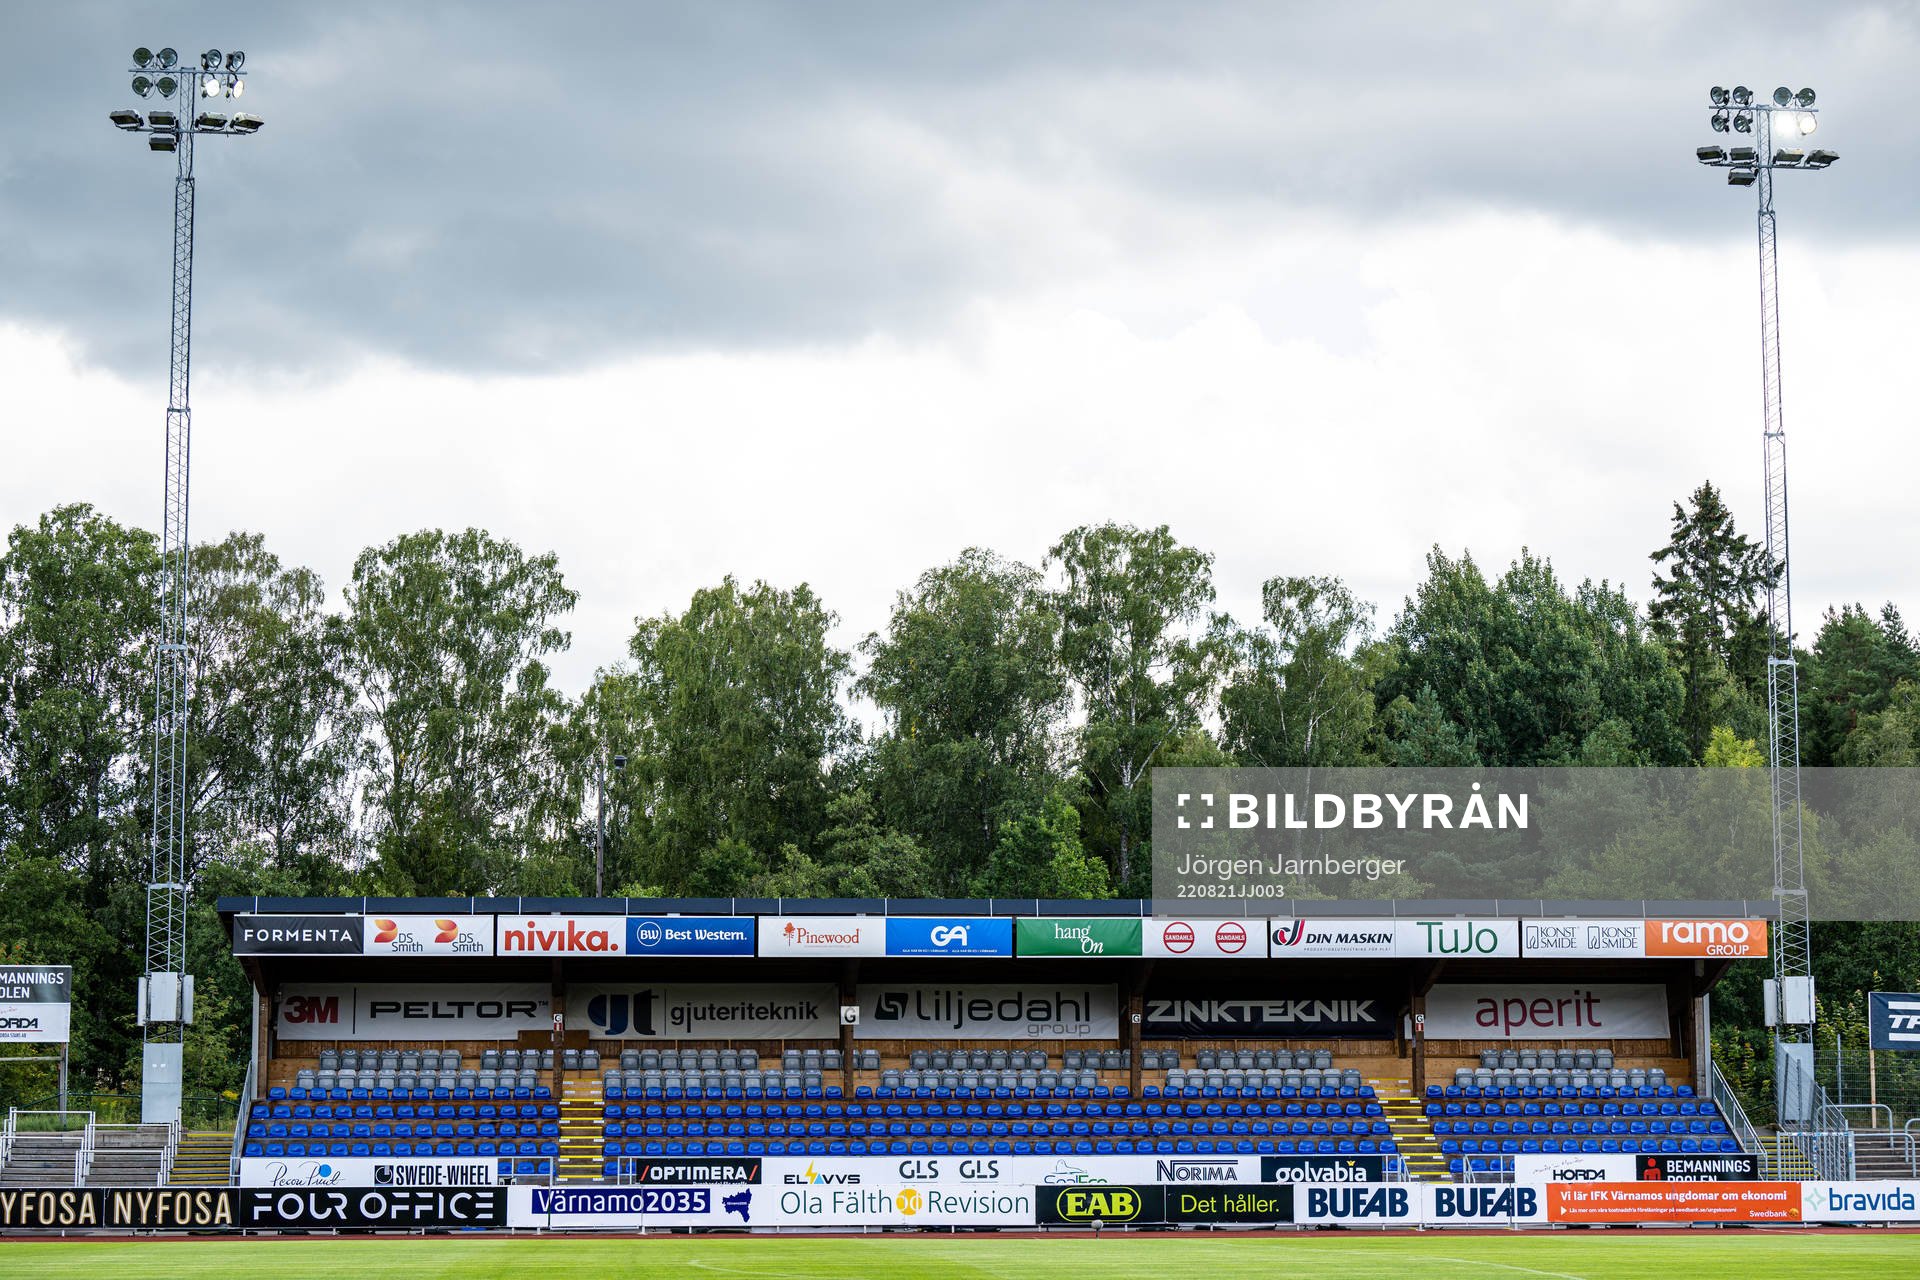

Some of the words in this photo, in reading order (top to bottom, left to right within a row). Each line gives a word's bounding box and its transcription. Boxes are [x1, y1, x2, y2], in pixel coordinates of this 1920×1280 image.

[244, 929, 353, 942] FORMENTA
[399, 933, 414, 944] DS
[459, 933, 474, 944] DS
[504, 920, 619, 952] nivika.
[640, 929, 659, 940] BW
[665, 928, 692, 940] Best
[695, 929, 748, 941] Western.
[796, 927, 860, 944] Pinewood
[1306, 933, 1332, 944] DIN
[1335, 933, 1393, 944] MASKIN
[1541, 926, 1577, 938] KONST
[1601, 926, 1637, 938] KONST
[1662, 922, 1749, 944] ramo
[392, 942, 424, 953] Smith
[452, 942, 484, 953] Smith
[1082, 936, 1104, 954] On
[1541, 938, 1577, 949] SMIDE
[1602, 938, 1638, 949] SMIDE
[1706, 944, 1749, 956] GROUP
[284, 996, 339, 1023] 3M
[670, 1001, 819, 1033] gjuteriteknik
[844, 1007, 856, 1023] G
[1146, 1000, 1376, 1022] ZINKTEKNIK
[1475, 990, 1602, 1036] aperit
[1027, 1023, 1091, 1037] group
[899, 1160, 939, 1179] GLS
[959, 1160, 999, 1179] GLS
[1157, 1159, 1239, 1182] NORIMA
[1276, 1161, 1367, 1182] golvabia
[1553, 1169, 1605, 1181] HORDA
[1667, 1160, 1751, 1173] BEMANNINGS
[396, 1165, 492, 1186] SWEDE-WHEEL
[781, 1190, 822, 1214] Ola
[833, 1190, 892, 1214] Fälth
[929, 1190, 1029, 1214] Revision
[1066, 1192, 1135, 1217] EAB
[1181, 1195, 1217, 1214] Det
[1224, 1193, 1280, 1214] håller.
[1308, 1188, 1409, 1217] BUFAB
[1435, 1188, 1538, 1217] BUFAB
[1560, 1190, 1572, 1201] Vi
[1574, 1190, 1588, 1201] lär
[1591, 1190, 1609, 1201] IFK
[1611, 1190, 1663, 1201] Värnamos
[1665, 1191, 1719, 1203] ungdomar
[1722, 1193, 1739, 1201] om
[1741, 1190, 1788, 1201] ekonomi
[1829, 1187, 1915, 1212] bravida
[113, 1191, 234, 1225] NYFOSA
[253, 1191, 348, 1220] FOUR
[360, 1191, 494, 1220] OFFICE
[1750, 1210, 1787, 1218] Swedbank
